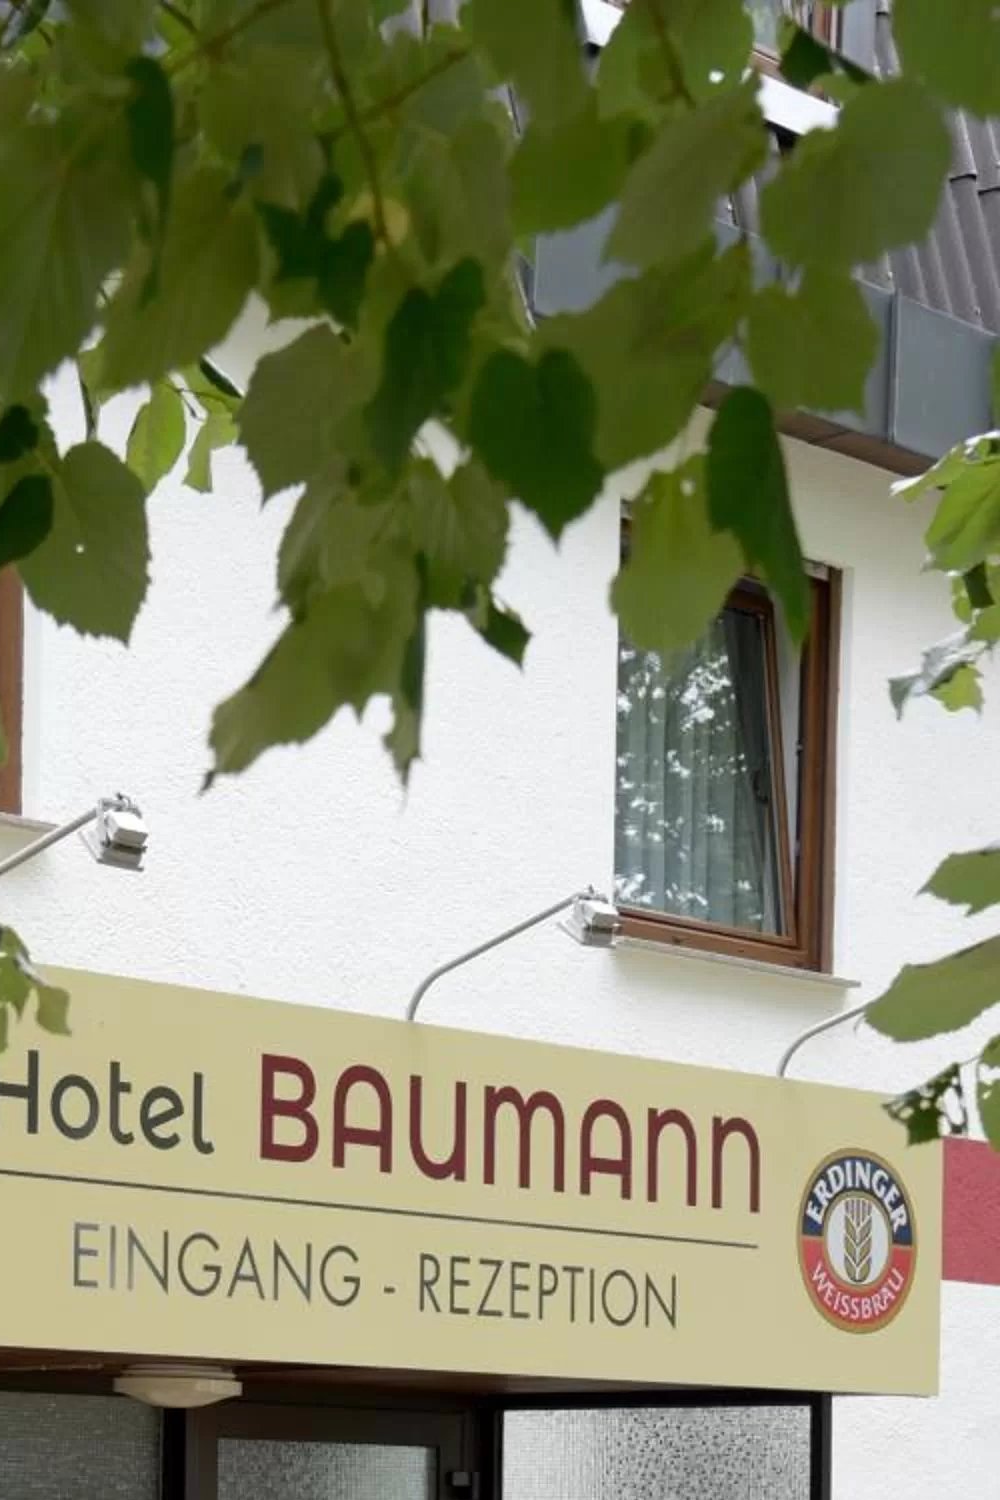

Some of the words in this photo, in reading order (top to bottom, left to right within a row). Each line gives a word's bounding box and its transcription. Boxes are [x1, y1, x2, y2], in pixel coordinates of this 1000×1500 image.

[260, 1053, 760, 1213] BAUMANN
[806, 1160, 908, 1232] ERDINGER
[72, 1222, 361, 1306] EINGANG
[420, 1253, 678, 1328] REZEPTION
